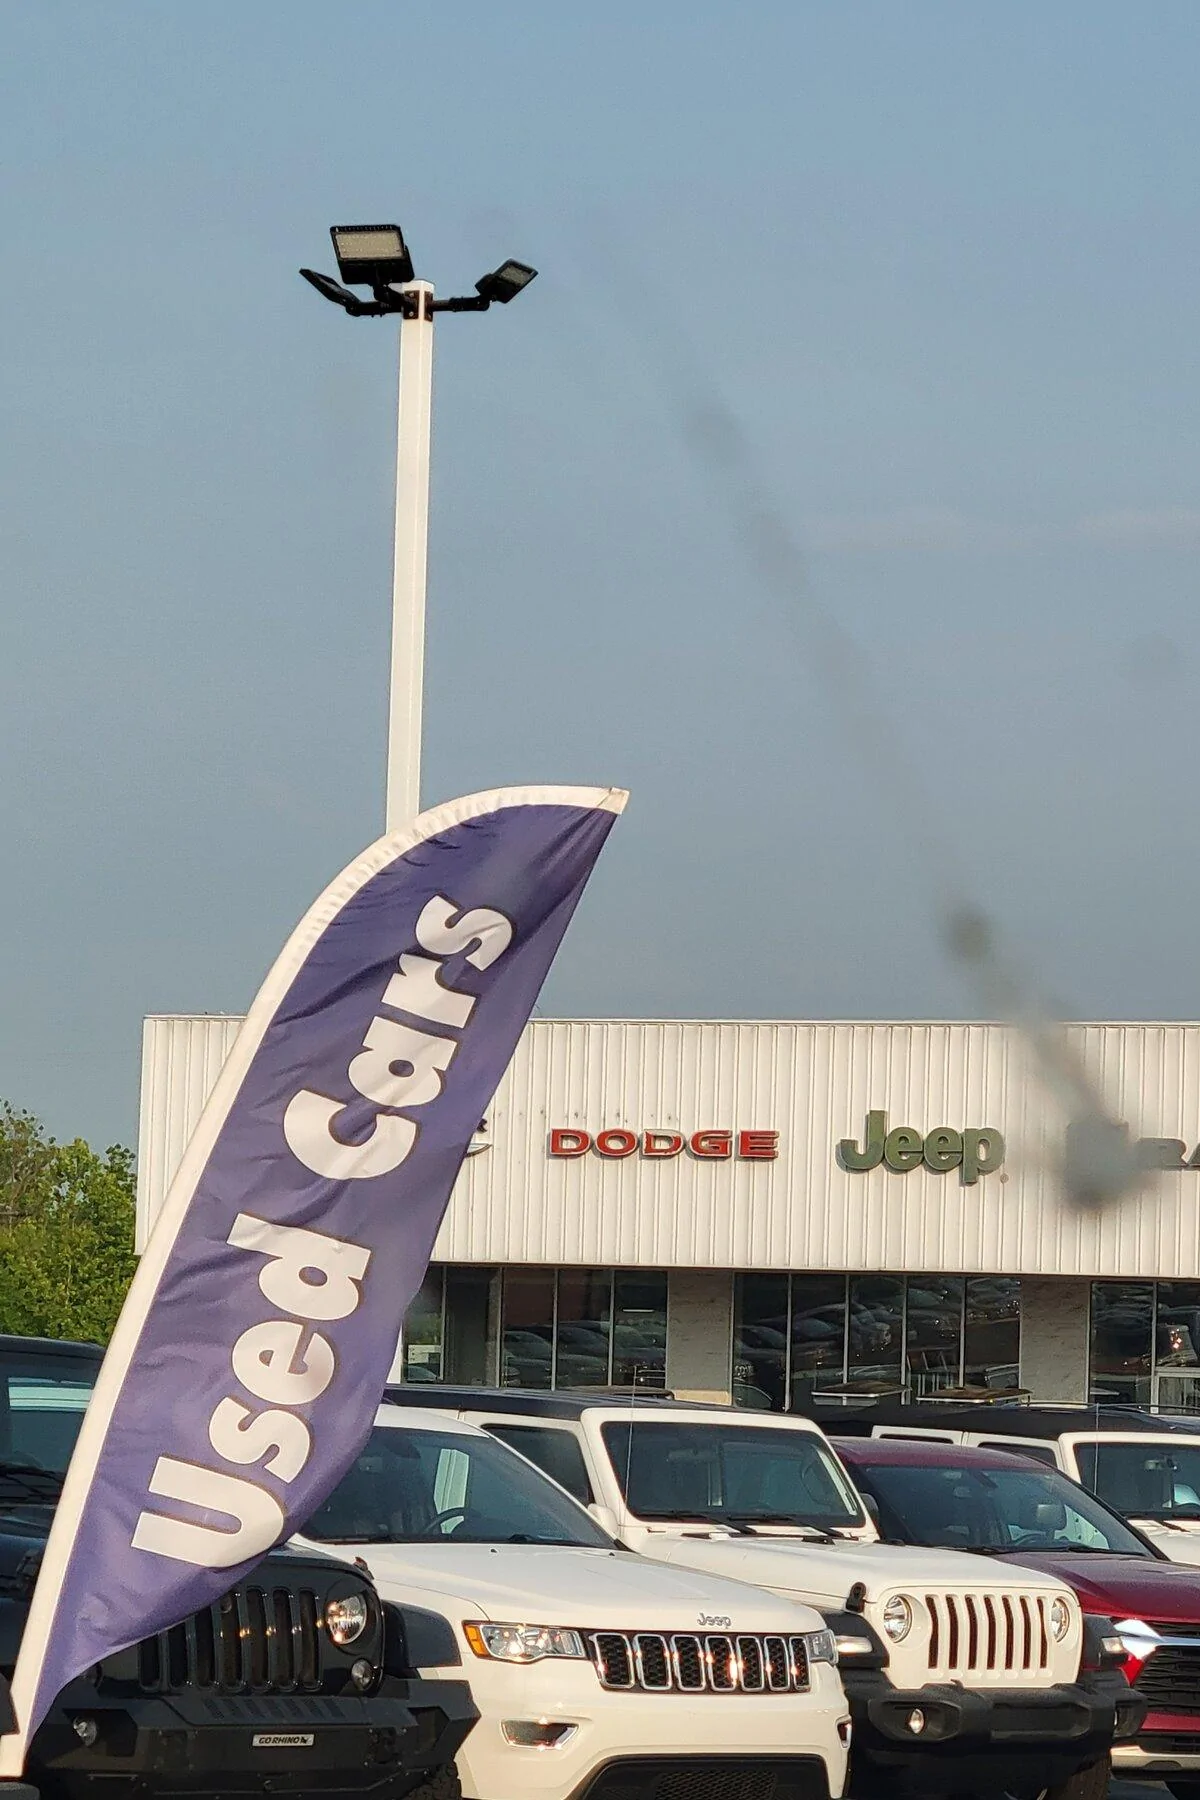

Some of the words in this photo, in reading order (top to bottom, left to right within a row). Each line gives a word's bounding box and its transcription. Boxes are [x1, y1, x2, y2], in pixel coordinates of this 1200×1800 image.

[549, 1128, 780, 1158] DODGE
[839, 1109, 1005, 1184] Jeep
[131, 1213, 373, 1568] Used
[282, 895, 514, 1180] Cars
[697, 1612, 731, 1630] Jeep
